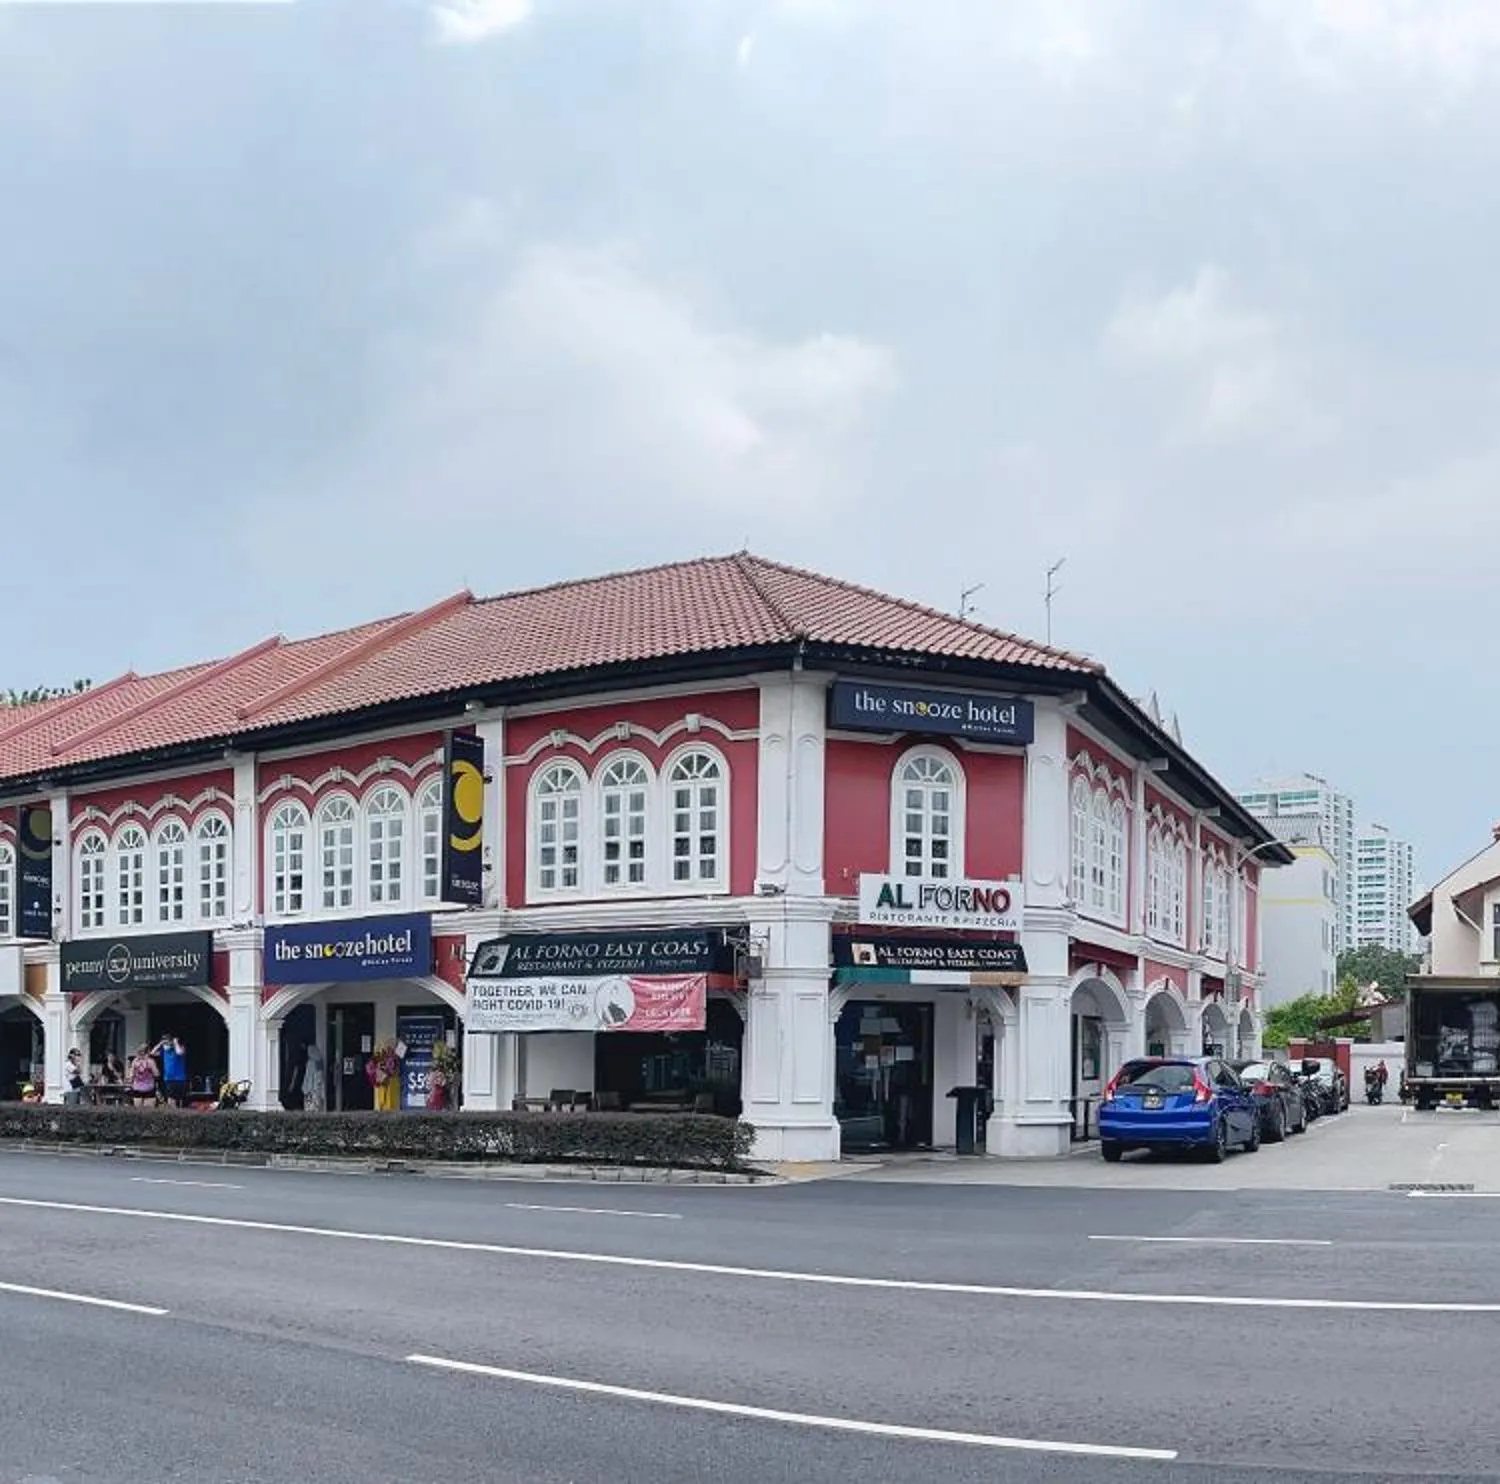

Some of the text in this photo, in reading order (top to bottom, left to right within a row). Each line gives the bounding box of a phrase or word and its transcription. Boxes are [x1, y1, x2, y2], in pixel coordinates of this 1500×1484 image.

[855, 690, 1016, 725] the snooze hotel
[876, 882, 1012, 914] AL FORNO
[275, 929, 412, 961] the snooze hotel
[511, 944, 533, 961] AL
[535, 943, 601, 960] FORNO
[604, 941, 650, 958] EAST
[878, 946, 895, 957] AL
[978, 949, 1018, 961] COAST
[65, 950, 201, 981] penny university
[539, 984, 557, 996] WE
[561, 983, 587, 996] CAN
